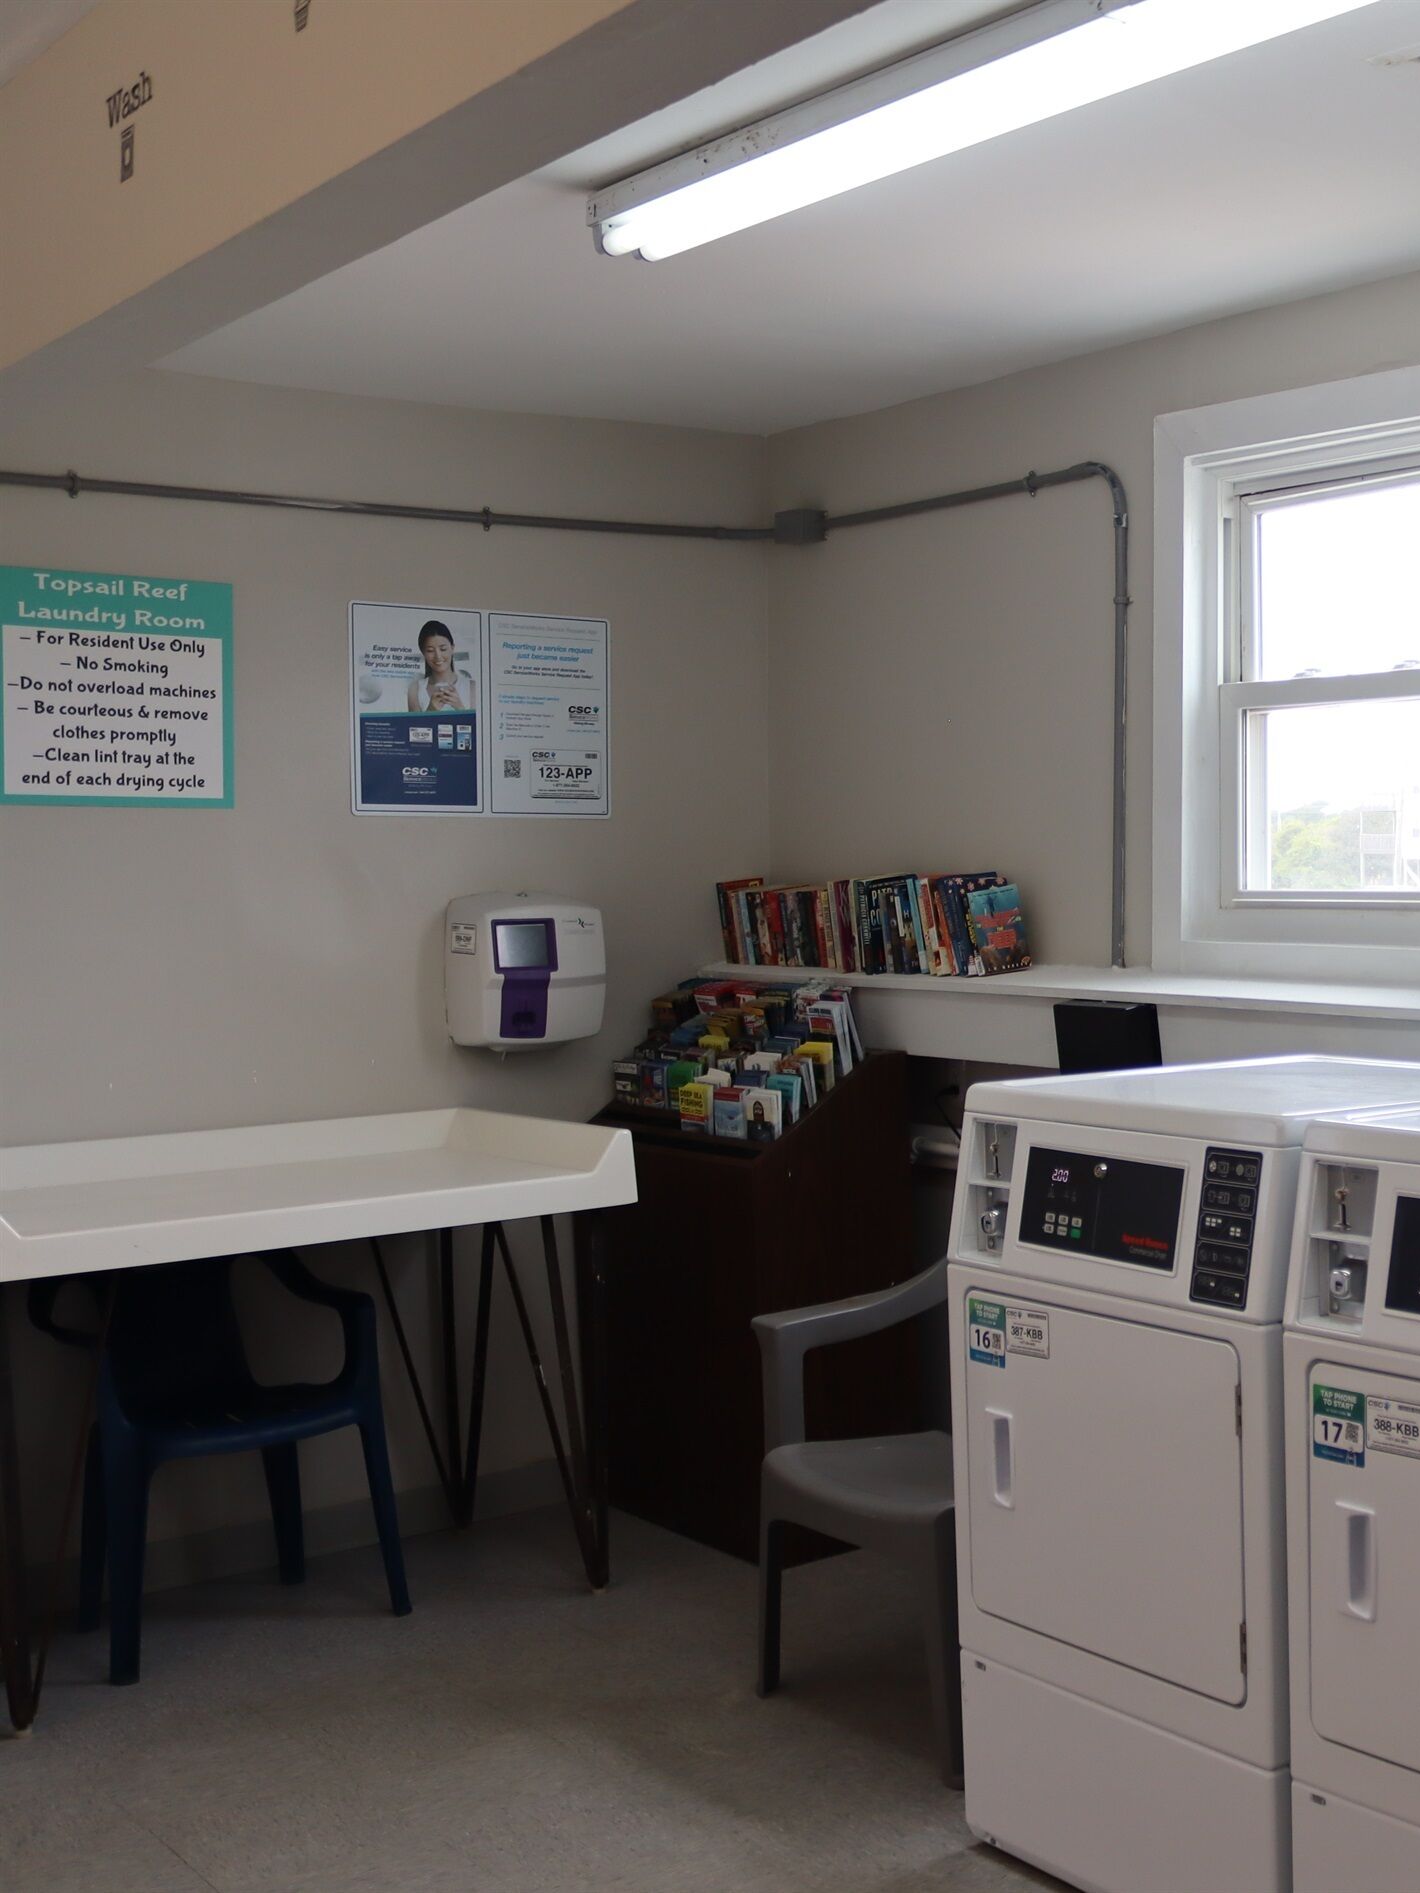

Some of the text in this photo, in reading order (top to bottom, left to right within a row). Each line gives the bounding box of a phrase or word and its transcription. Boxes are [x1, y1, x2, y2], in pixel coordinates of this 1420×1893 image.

[106, 70, 152, 128] Wash
[33, 572, 189, 601] Topsail Reef
[18, 601, 206, 630] Laundry Room
[36, 630, 205, 658] For Resident Use Only
[76, 656, 169, 679] No Smoking
[48, 679, 217, 699] not overload machines
[34, 700, 209, 721] Be courteous & remove
[568, 705, 592, 714] CSC
[52, 725, 176, 747] clothes promptly
[94, 749, 196, 768] lint tray at the
[22, 770, 205, 792] end of each drying cycle
[402, 767, 429, 776] CSC
[538, 767, 593, 779] 123-APP
[975, 1328, 991, 1350] 16
[1010, 1325, 1043, 1341] 387-KBB
[1333, 1400, 1355, 1411] START
[1321, 1420, 1343, 1444] 17
[1374, 1418, 1420, 1438] 388-KBB
